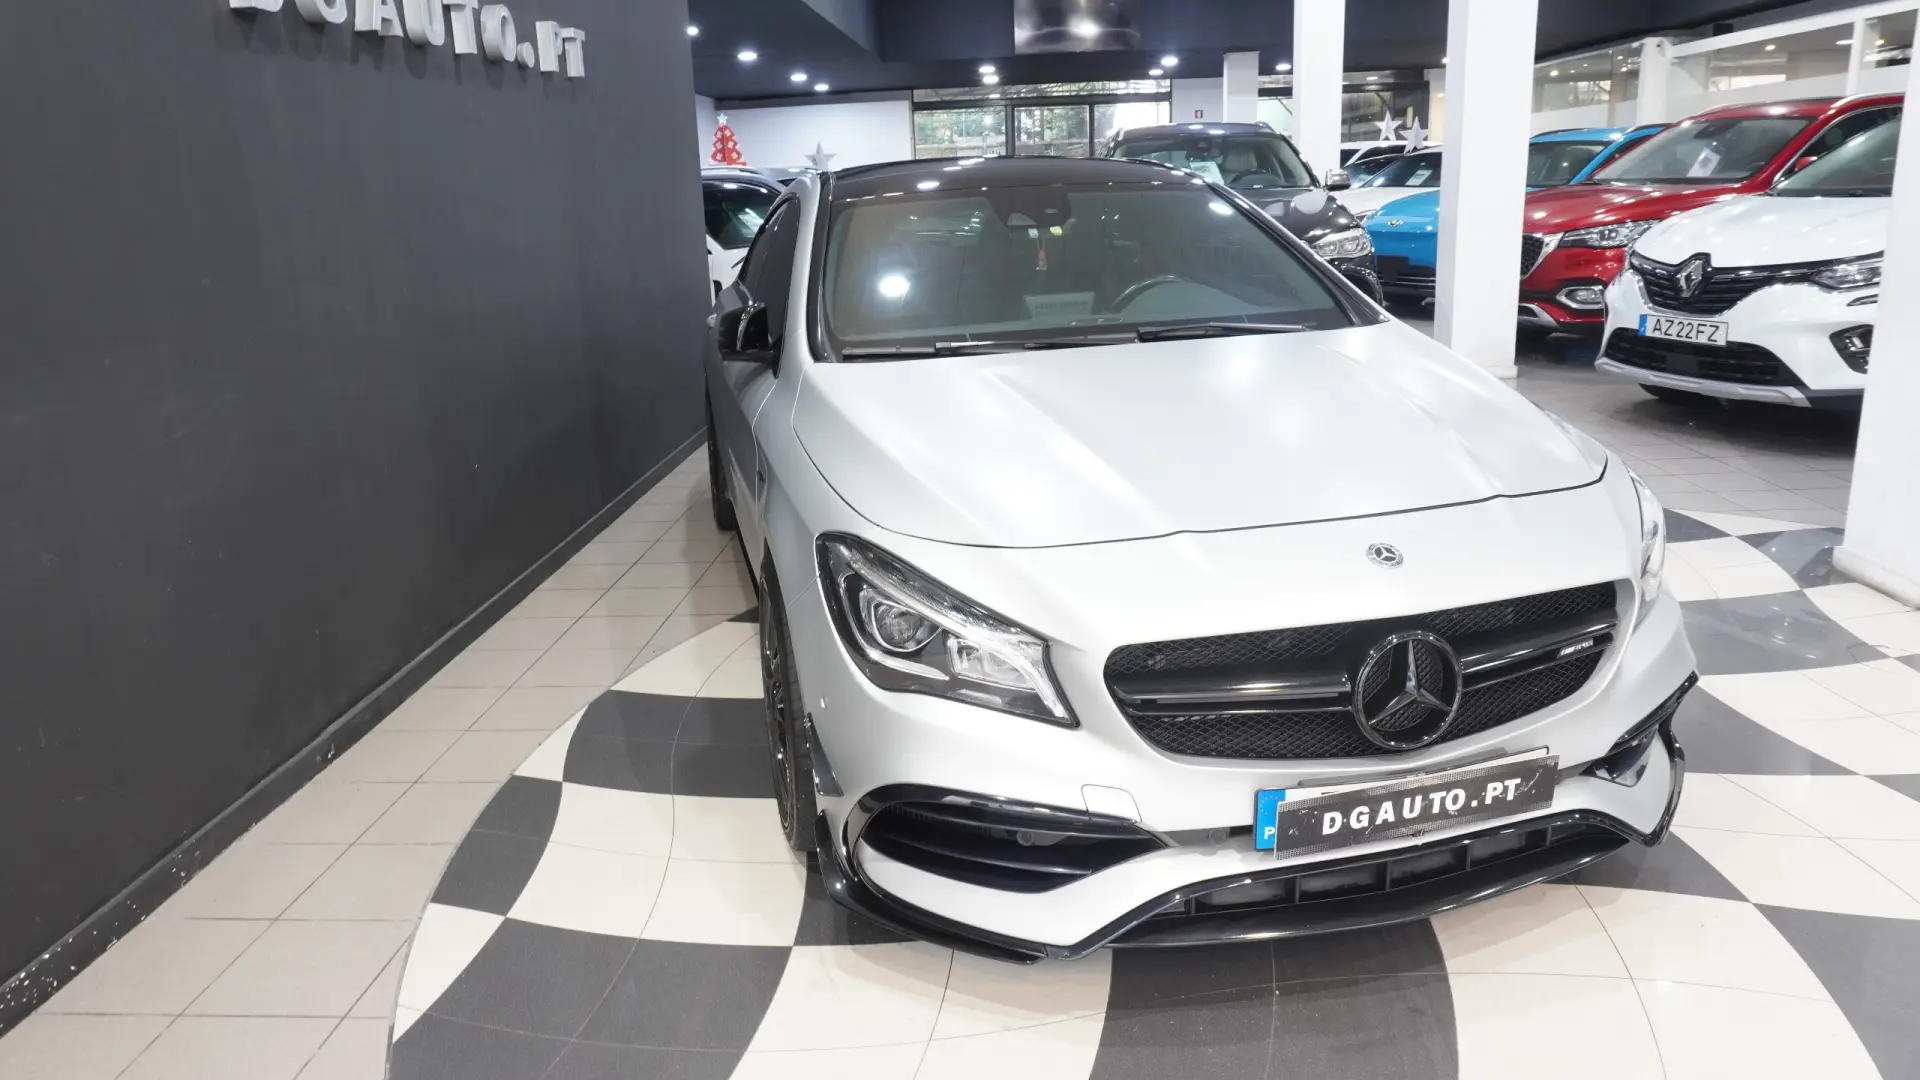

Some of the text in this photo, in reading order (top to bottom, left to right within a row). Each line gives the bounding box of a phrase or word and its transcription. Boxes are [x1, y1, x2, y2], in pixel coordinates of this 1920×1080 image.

[229, 0, 586, 78] AUTO.PT
[1652, 318, 1720, 342] AZ22FZ
[1264, 826, 1276, 840] P
